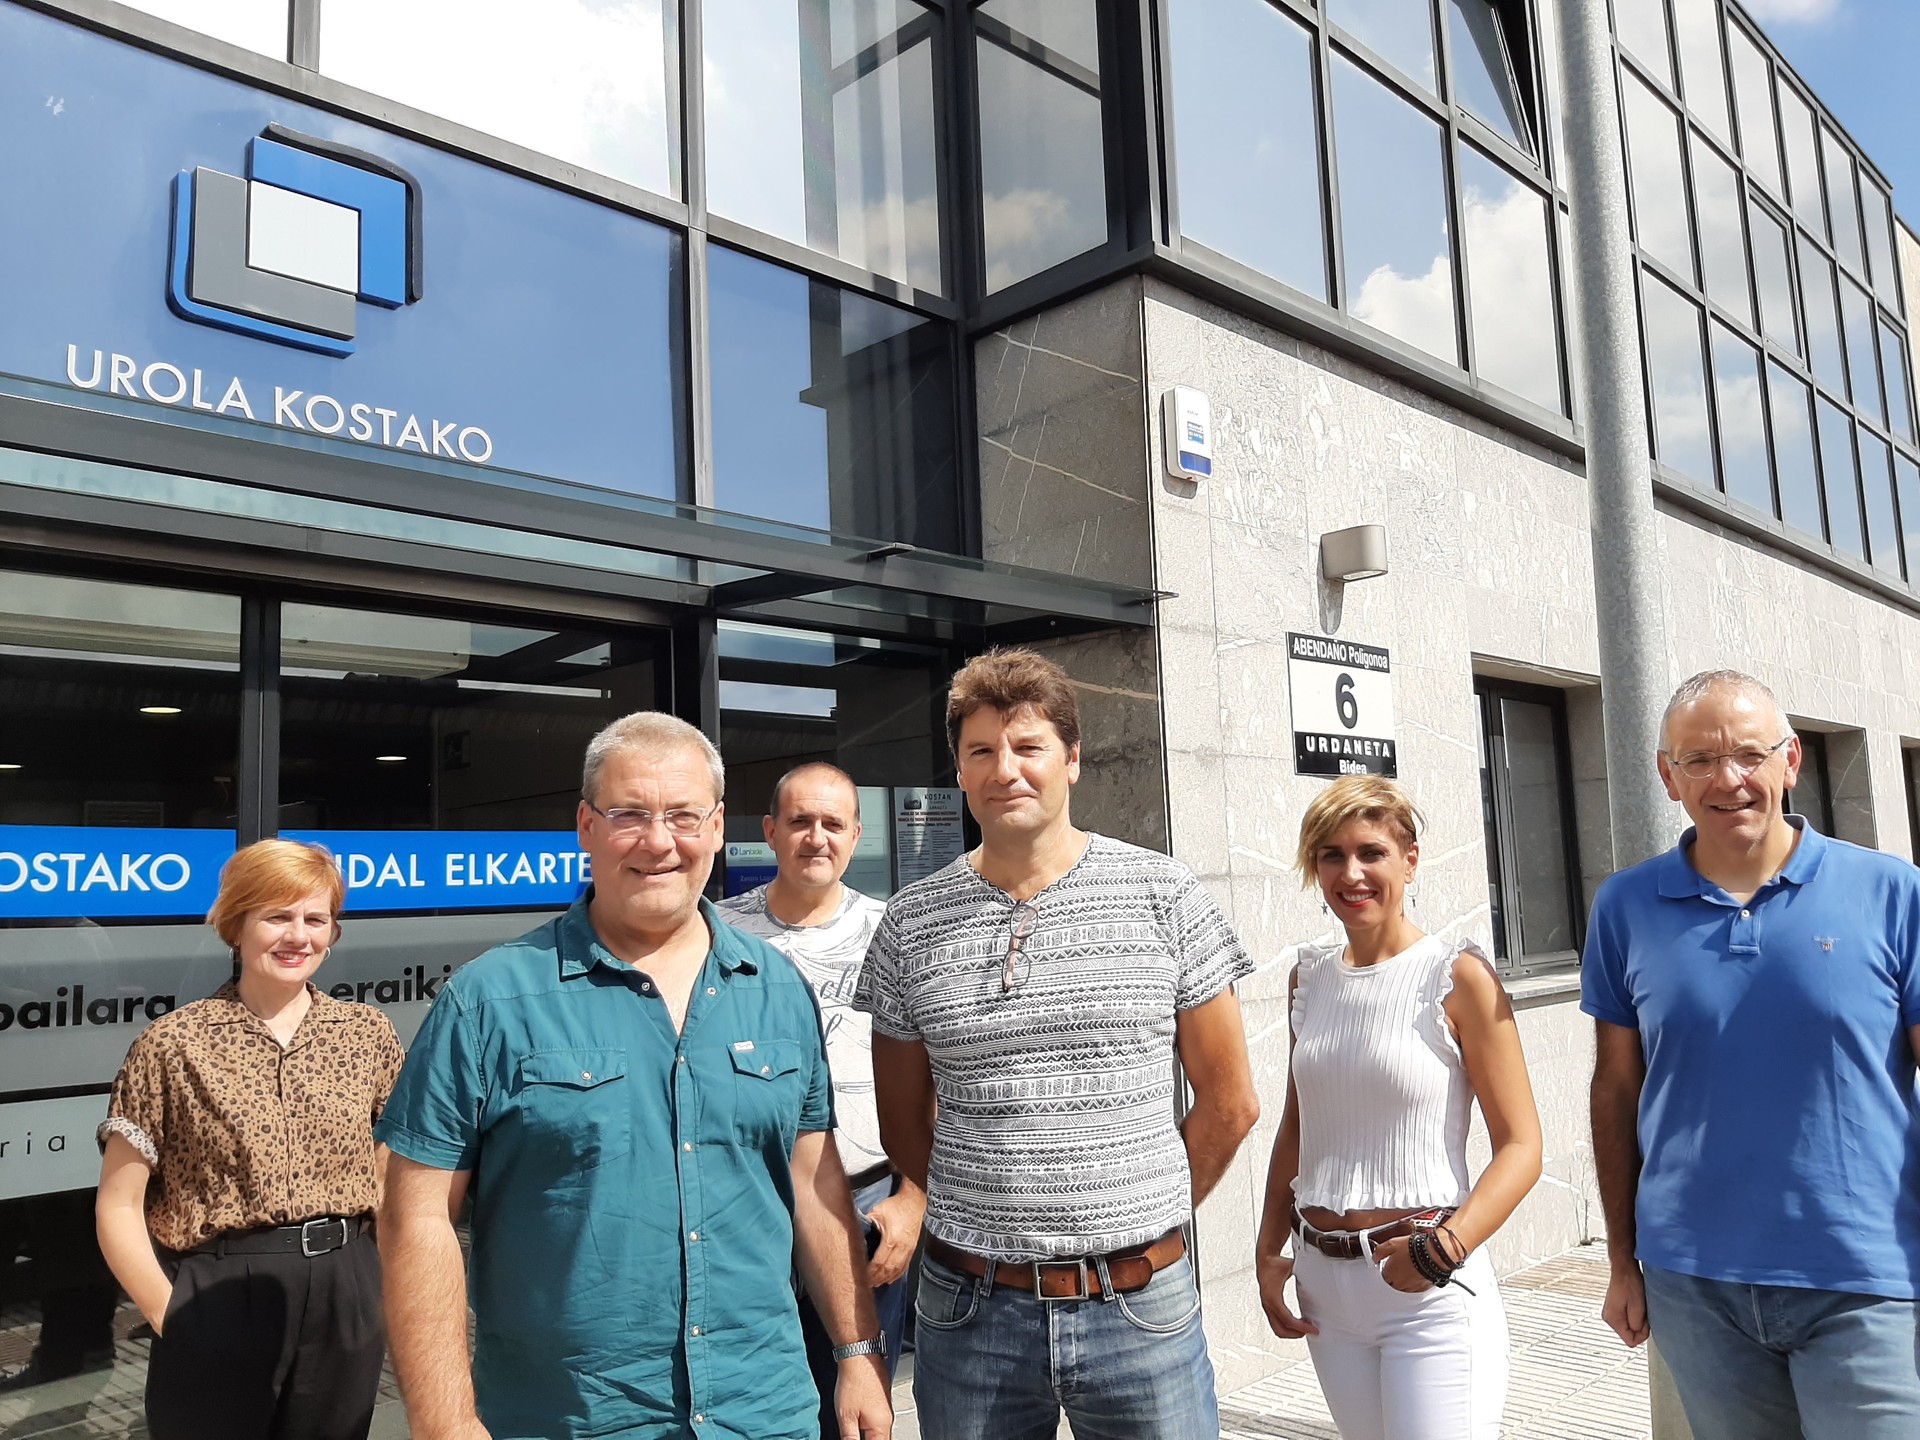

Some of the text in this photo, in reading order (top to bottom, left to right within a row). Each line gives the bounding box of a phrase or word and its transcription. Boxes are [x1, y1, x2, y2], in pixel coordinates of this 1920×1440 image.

[66, 343, 492, 463] UROLA KOSTAKO
[1293, 637, 1388, 669] ABENDAÑO Poligonoa
[1335, 672, 1358, 729] 6
[1305, 735, 1390, 757] URDANETA
[1339, 759, 1367, 774] Bidea
[335, 852, 425, 888] DAL
